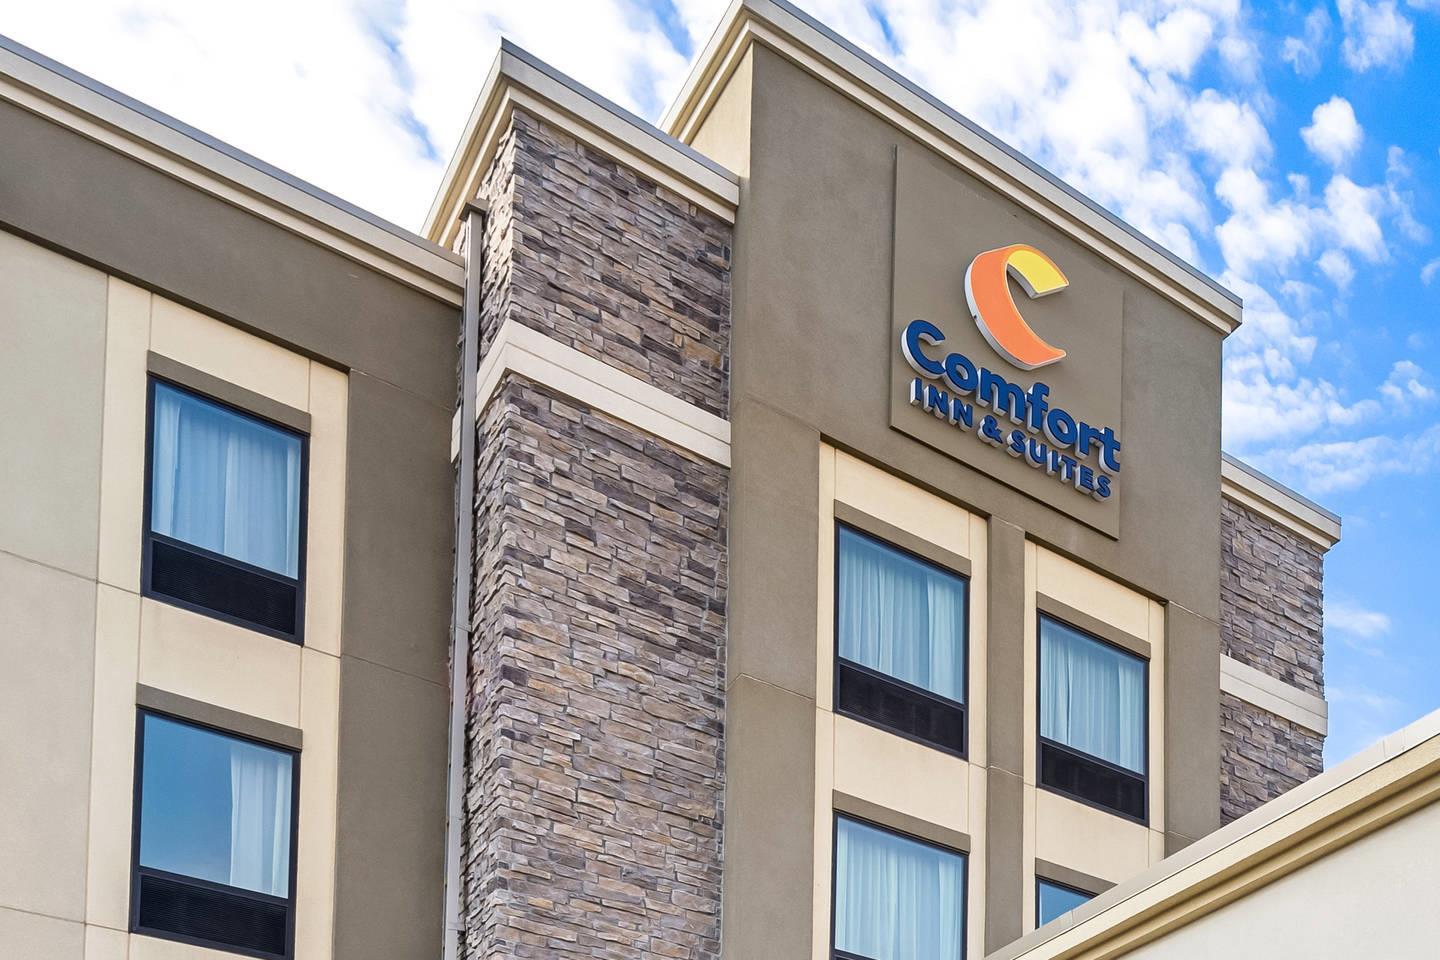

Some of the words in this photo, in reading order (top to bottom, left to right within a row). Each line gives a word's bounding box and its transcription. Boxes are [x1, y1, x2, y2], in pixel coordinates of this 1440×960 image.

[901, 319, 1121, 474] Comfort
[910, 377, 973, 431] INN
[977, 415, 1004, 449] &
[1006, 430, 1111, 501] SUITES
